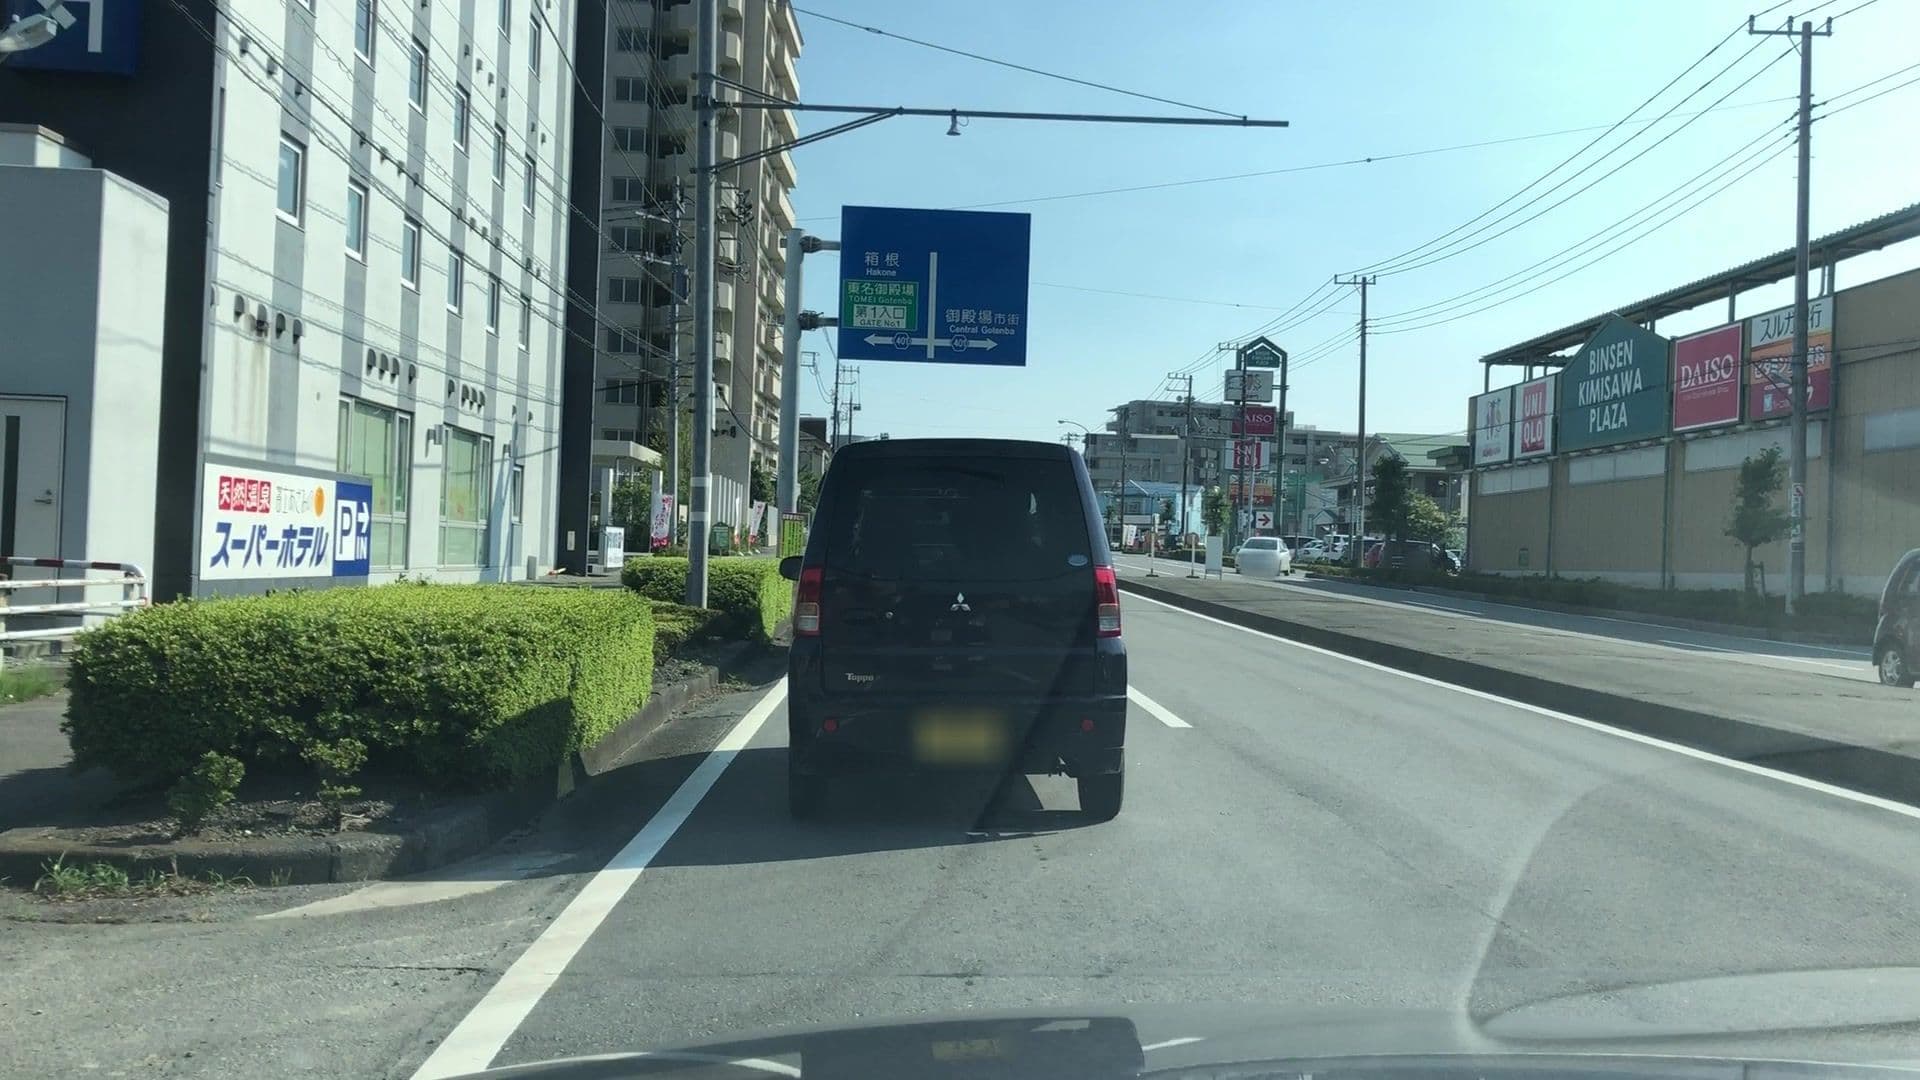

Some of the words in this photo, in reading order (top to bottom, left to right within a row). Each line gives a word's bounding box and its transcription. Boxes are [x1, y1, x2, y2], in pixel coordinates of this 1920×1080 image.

[865, 251, 900, 267] 箱根
[866, 268, 897, 277] Hakone
[847, 282, 914, 296] 東名御殿場
[880, 297, 912, 305] Gotenba
[855, 305, 905, 319] 第1入口
[860, 319, 881, 327] GATE
[945, 308, 1020, 325] 御殿場市街
[949, 324, 978, 334] Central
[981, 326, 1015, 335] Gotenba
[1589, 339, 1633, 375] BINSEN
[1680, 354, 1734, 389] DAISO
[1578, 367, 1642, 407] KIMISAWA
[1524, 391, 1543, 417] UNI
[1589, 402, 1628, 433] PLAZA
[1523, 420, 1543, 448] QLO
[219, 478, 271, 512] 天然温泉
[339, 506, 353, 554] P
[210, 522, 329, 568] スーパーホテル
[356, 536, 368, 560] IN
